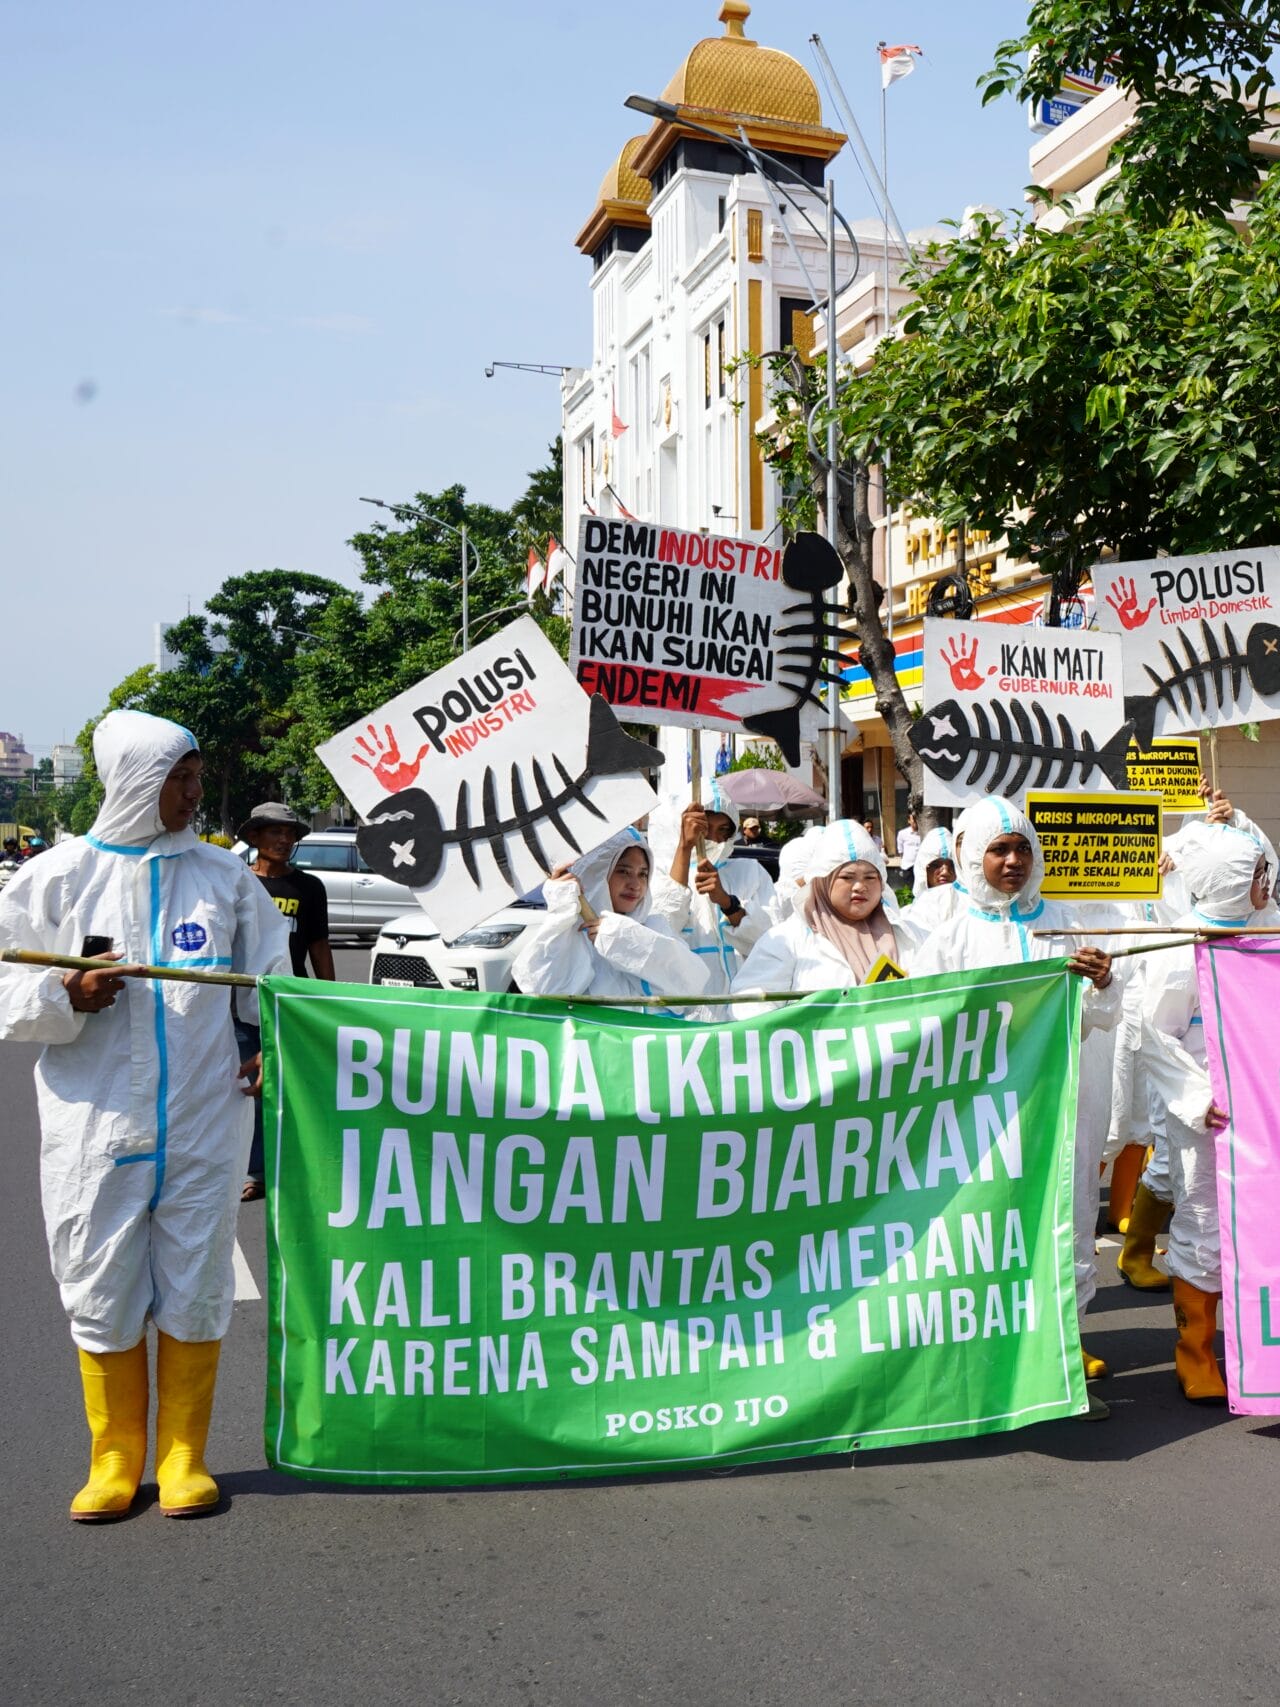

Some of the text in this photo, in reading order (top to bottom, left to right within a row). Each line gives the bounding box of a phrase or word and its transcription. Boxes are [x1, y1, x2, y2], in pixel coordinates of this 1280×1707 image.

[585, 520, 780, 581] DEMI INDUSTRI
[583, 558, 736, 604] NEGERI INI
[1151, 560, 1265, 608] POLUSI
[581, 589, 771, 647] BUNUHI IKAN
[580, 627, 773, 681] IKAN SUNGAI
[1001, 644, 1104, 681] IKAN MATI
[412, 648, 536, 754] POLUSI
[1000, 678, 1112, 699] GUBERNUR ABAI
[445, 689, 536, 758] INDUSTRI
[1128, 778, 1198, 786] RDA LARANGAN
[1035, 812, 1155, 825] KRISIS MIKROPLASTIK
[1062, 836, 1069, 846] Z
[1074, 836, 1109, 847] JATIM
[1113, 836, 1155, 847] DUKUNG
[1043, 850, 1155, 863] ERDA LARANGAN
[1045, 867, 1154, 877] ASTIK SEKALI PAKAI
[336, 1026, 605, 1122] BUNDA
[327, 1092, 1023, 1229] JANGAN BIARKAN
[329, 1208, 1028, 1329] KALI BRANTAS MERANA
[325, 1278, 1035, 1396] KARENA SAMPAH & LIMBAH
[605, 1394, 789, 1437] POSKO IJO
